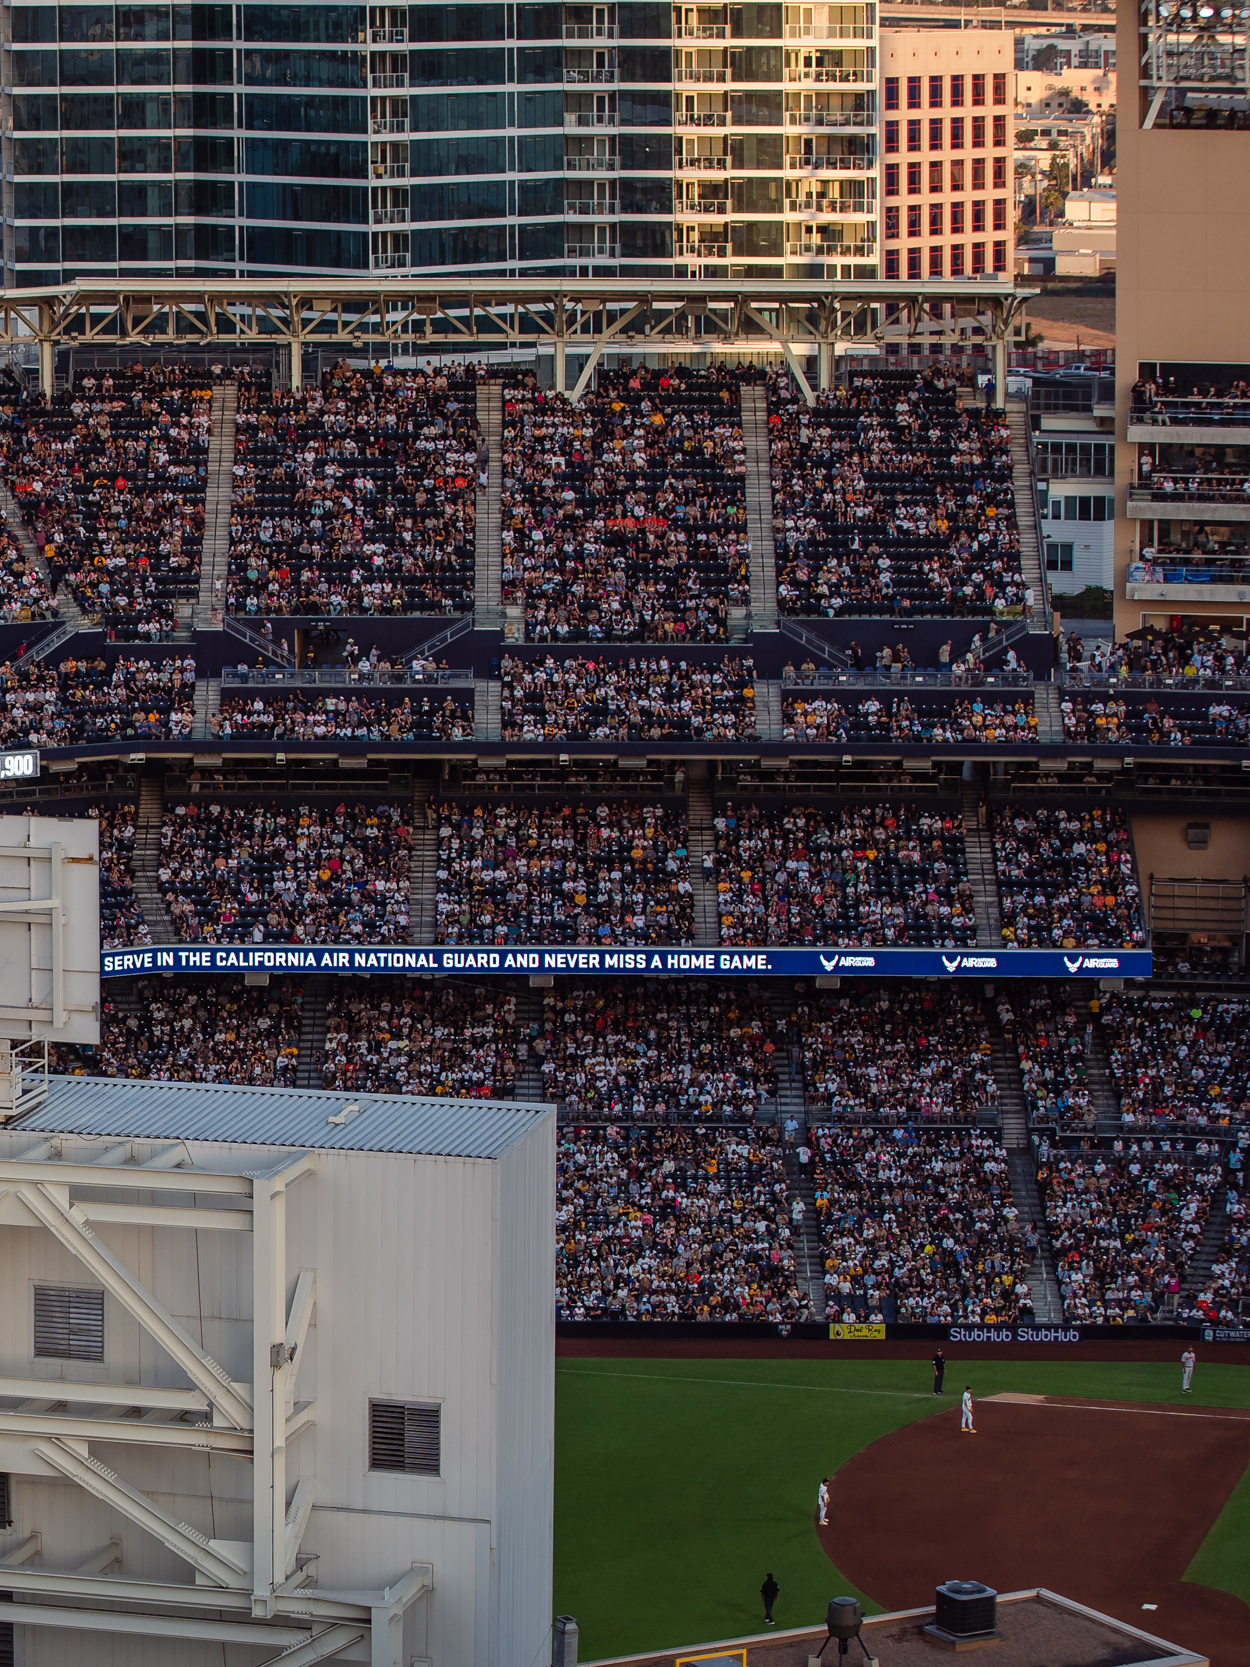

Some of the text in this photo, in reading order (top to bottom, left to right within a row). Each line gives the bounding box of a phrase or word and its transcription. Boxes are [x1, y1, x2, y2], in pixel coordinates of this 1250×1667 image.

[104, 951, 772, 972] SERVE IN THE CALIFORNIA AIR NATIONAL GUARD AND NEVER MISS A HOME GAME.
[839, 957, 855, 966] AIR
[961, 958, 978, 968] AIR
[1082, 958, 1099, 968] AIR
[950, 1327, 1079, 1342] StubHub StubHub
